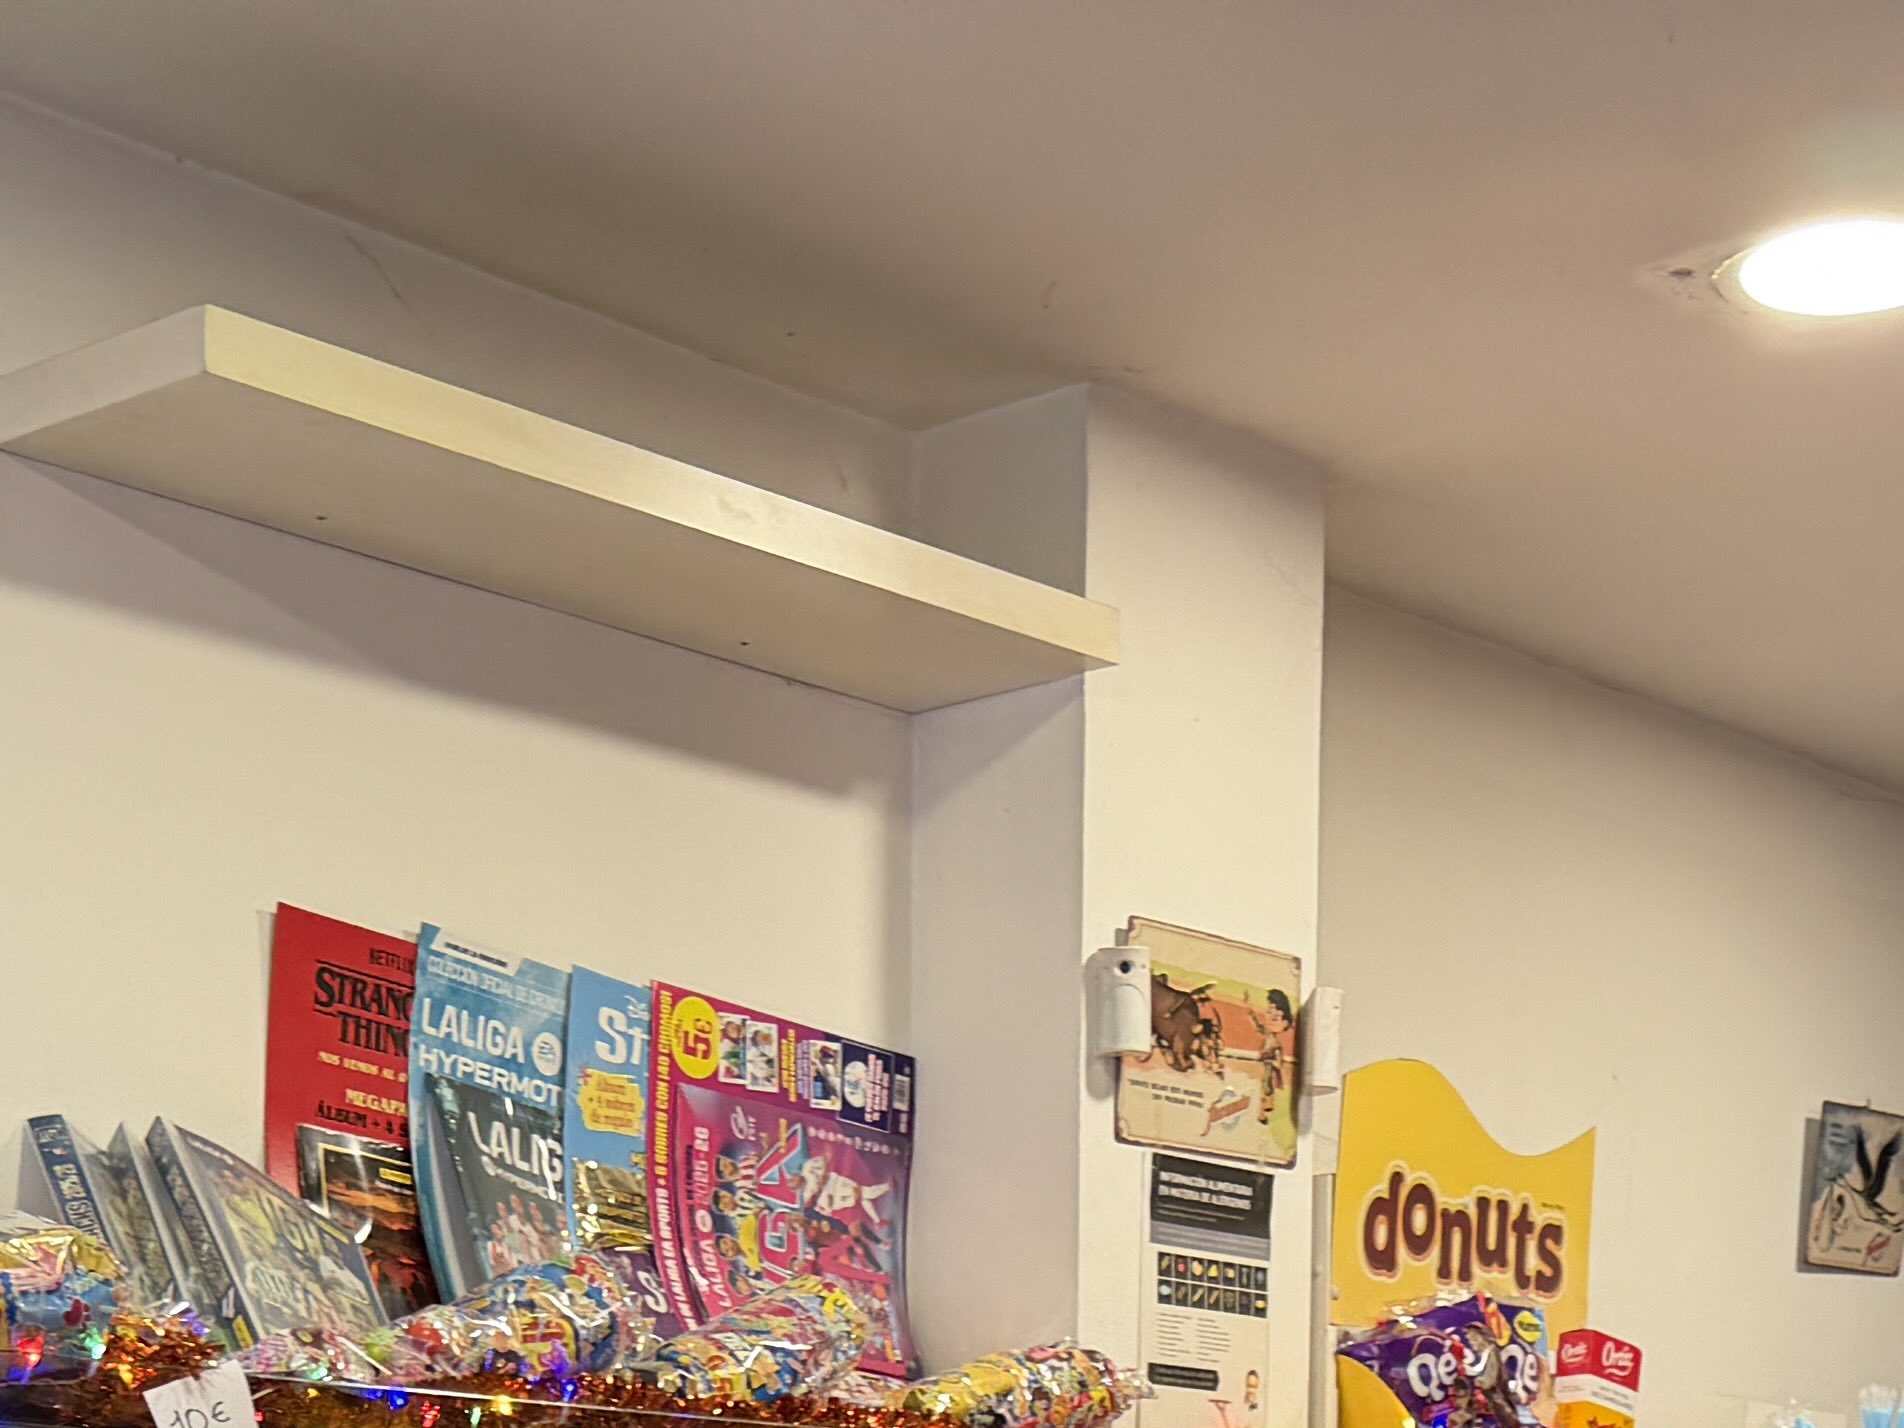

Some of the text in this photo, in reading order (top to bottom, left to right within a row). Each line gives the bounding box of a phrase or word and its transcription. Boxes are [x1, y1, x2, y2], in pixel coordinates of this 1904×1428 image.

[421, 997, 526, 1064] LALIGA
[418, 1043, 564, 1108] HYPERMOT
[1363, 1170, 1565, 1295] donuts
